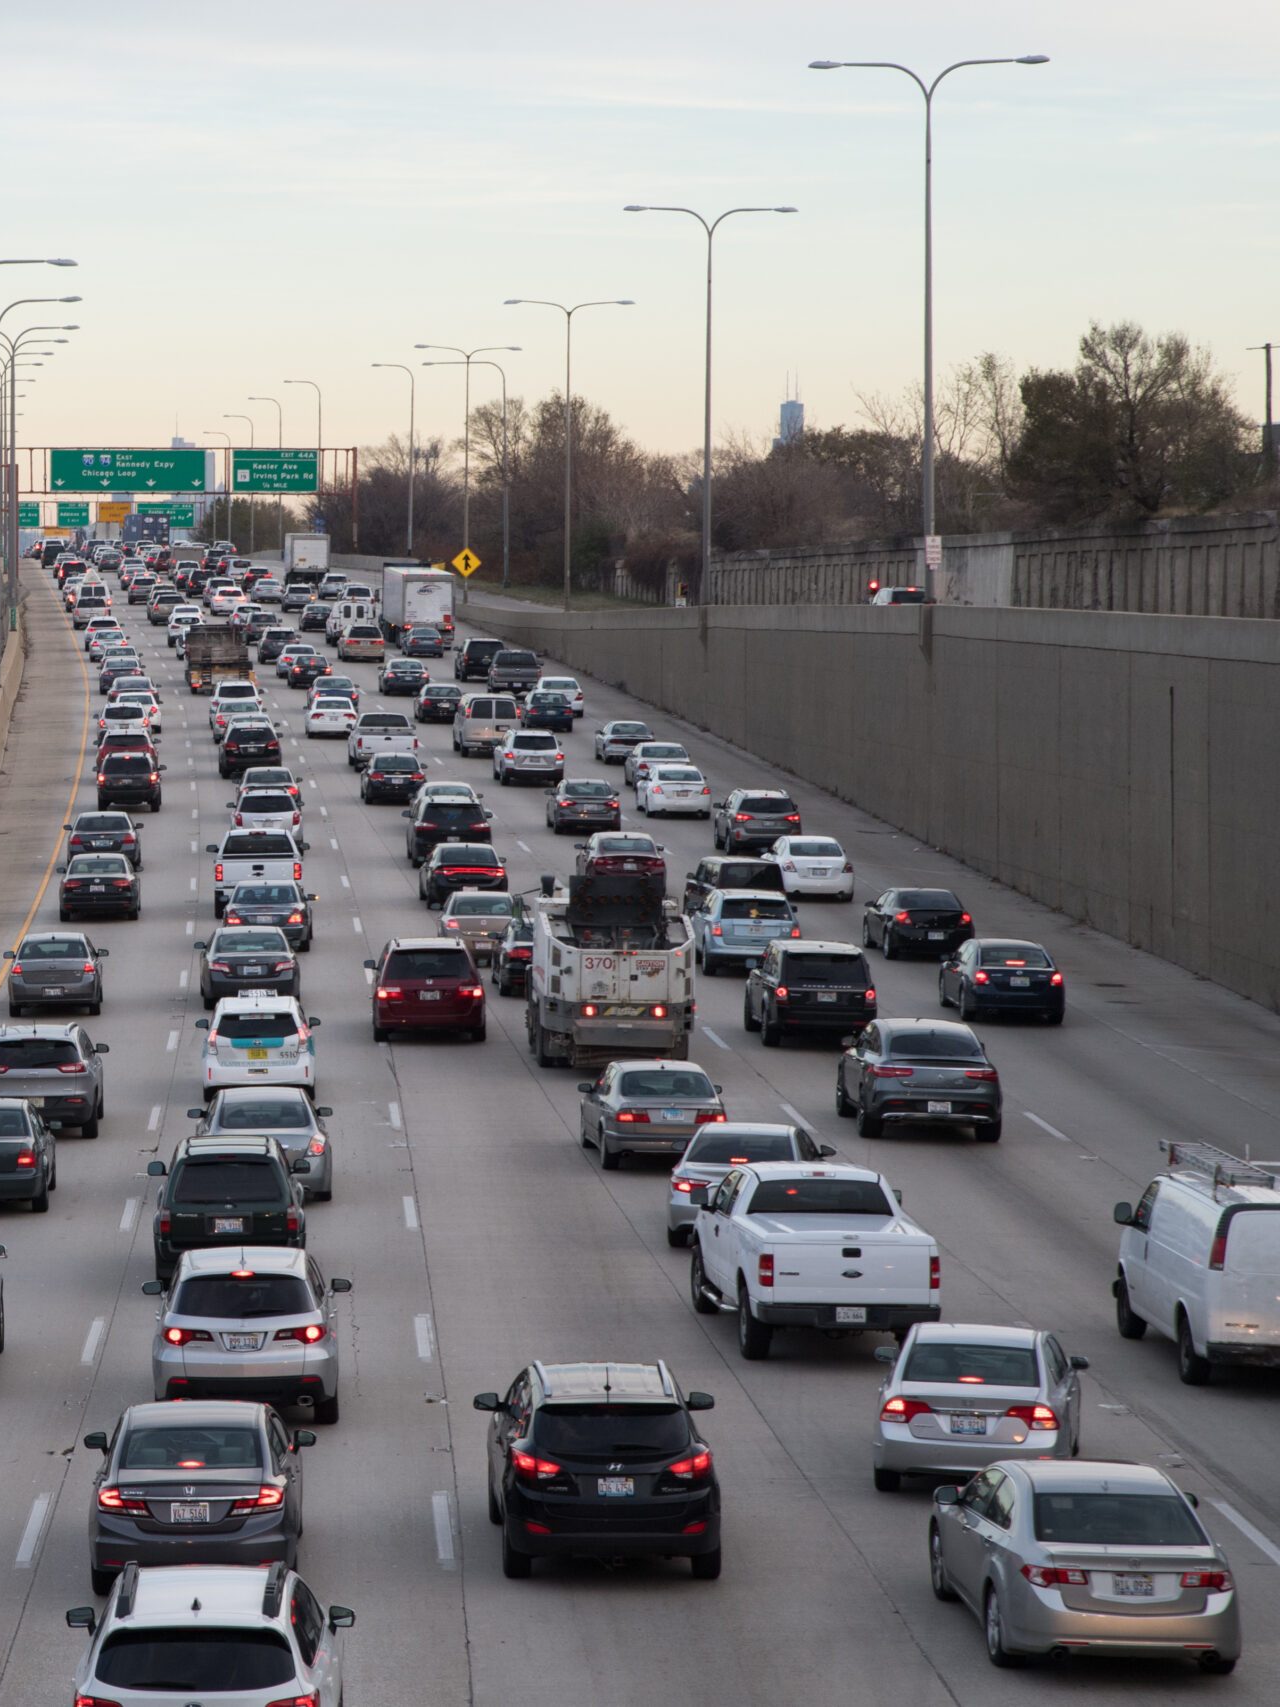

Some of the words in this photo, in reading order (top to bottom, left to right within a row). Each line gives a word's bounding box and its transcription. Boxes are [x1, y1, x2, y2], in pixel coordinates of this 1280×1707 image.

[81, 469, 114, 477] Chicago
[118, 469, 136, 477] Loop
[585, 957, 613, 969] 370
